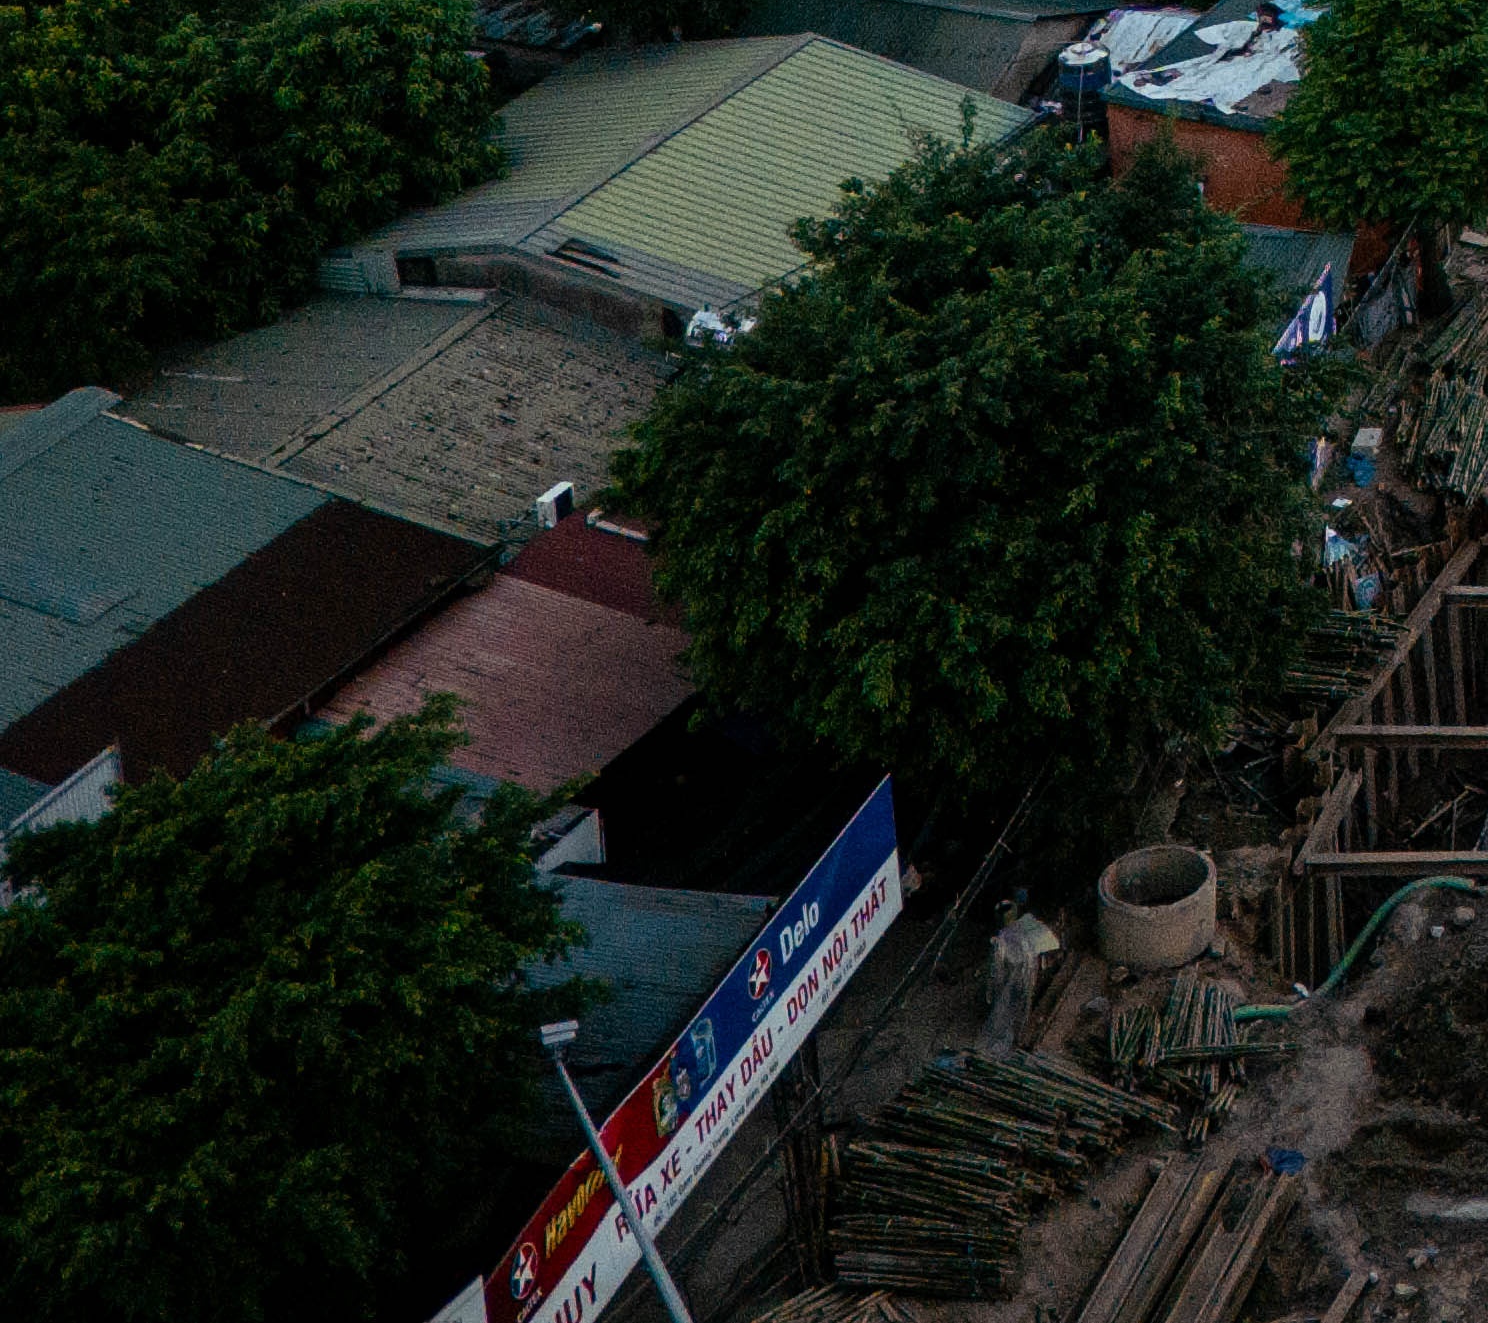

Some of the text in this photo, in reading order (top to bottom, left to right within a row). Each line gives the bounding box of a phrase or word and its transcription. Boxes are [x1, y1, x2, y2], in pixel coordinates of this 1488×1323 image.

[779, 901, 820, 965] Delo
[660, 1149, 682, 1194] XE
[695, 1074, 735, 1142] THAY
[786, 969, 818, 1025] DỌN
[821, 932, 849, 979] NỘI
[850, 876, 887, 941] THẤT
